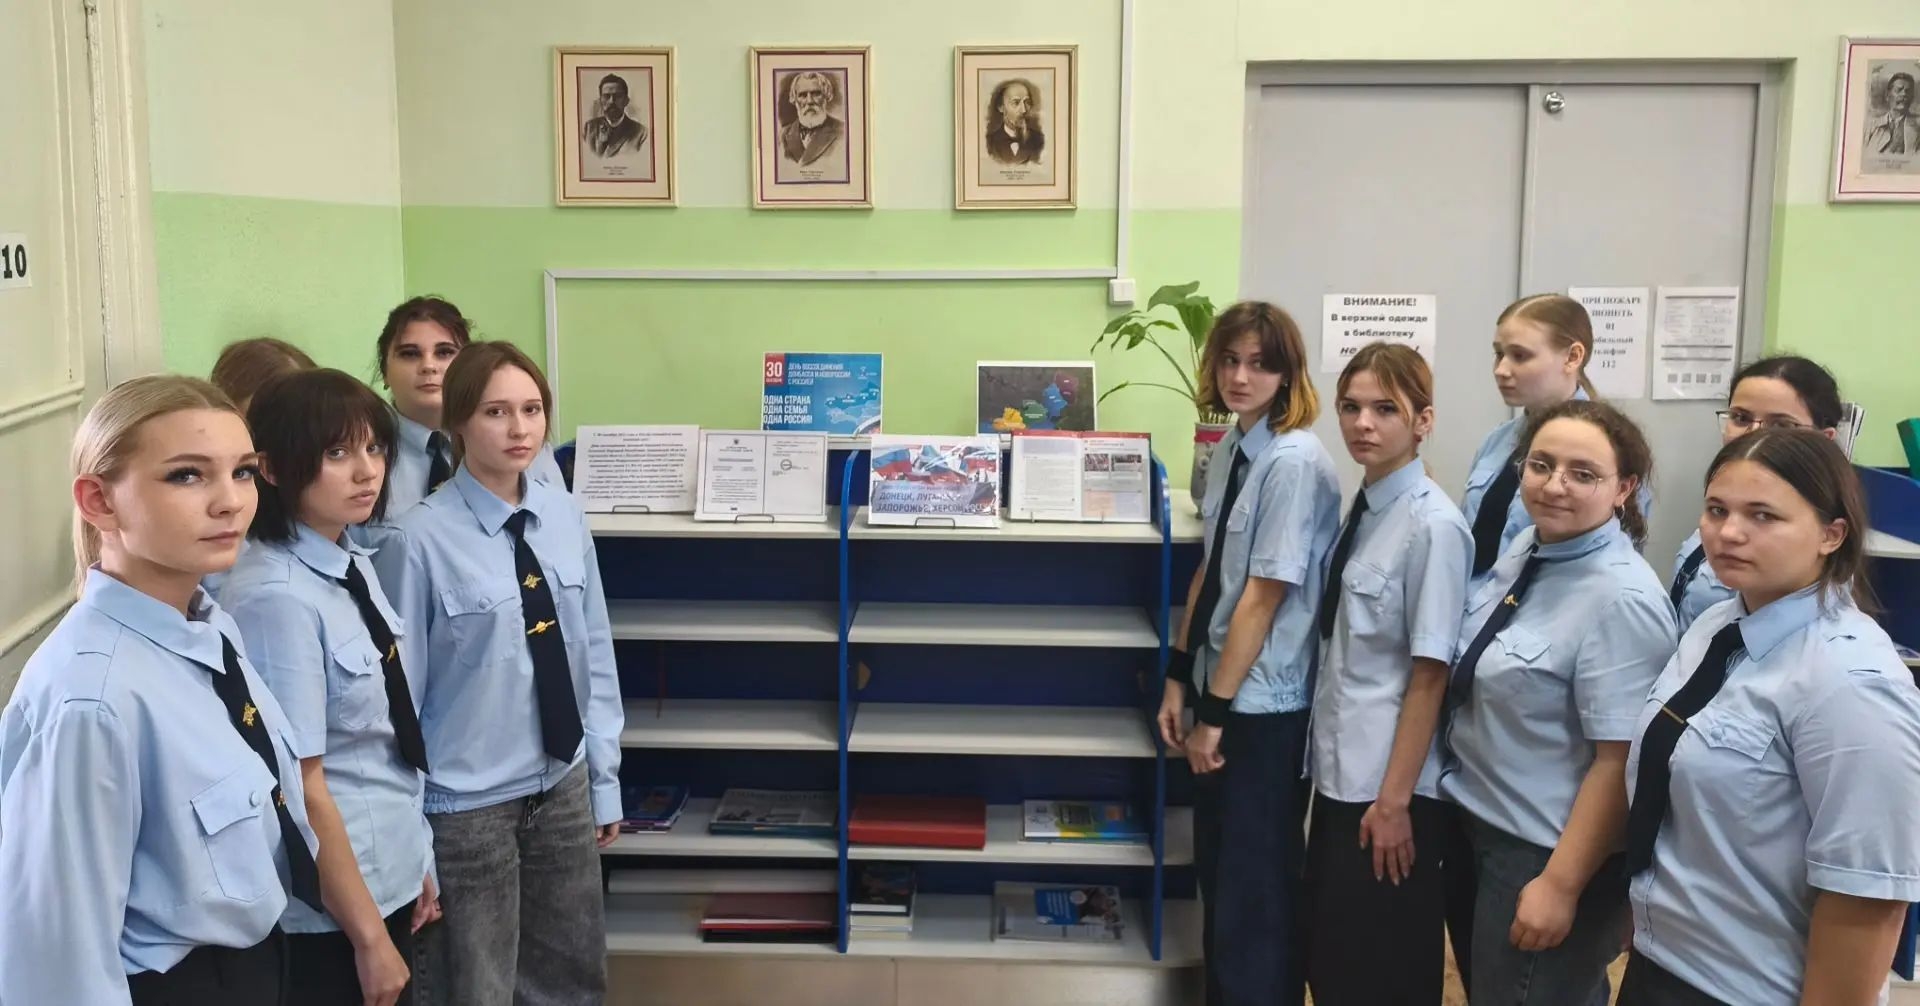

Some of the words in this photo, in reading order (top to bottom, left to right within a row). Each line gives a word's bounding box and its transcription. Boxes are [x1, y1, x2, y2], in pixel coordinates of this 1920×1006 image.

[2, 244, 27, 279] 10
[1343, 297, 1417, 307] ВНИМАНИЕ!
[1582, 296, 1601, 304] ПРИ
[1331, 313, 1338, 321] В
[1341, 314, 1385, 323] верхней
[1388, 315, 1428, 323] одежде
[1605, 322, 1615, 331] 01
[1352, 328, 1415, 339] библиотеку
[1593, 336, 1634, 345] обильный
[1340, 345, 1358, 355] не
[766, 361, 783, 378] 30
[788, 363, 802, 371] ДЕНЬ
[1602, 360, 1616, 369] 112
[764, 395, 783, 405] ОДНА
[784, 395, 811, 405] СТРАНА
[763, 405, 783, 415] ОДНА
[784, 405, 808, 414] СЕМЬЯ
[763, 415, 783, 425] ОДНА
[784, 415, 813, 425] РОССИЯ!
[880, 491, 915, 502] ДОНЕЦК,
